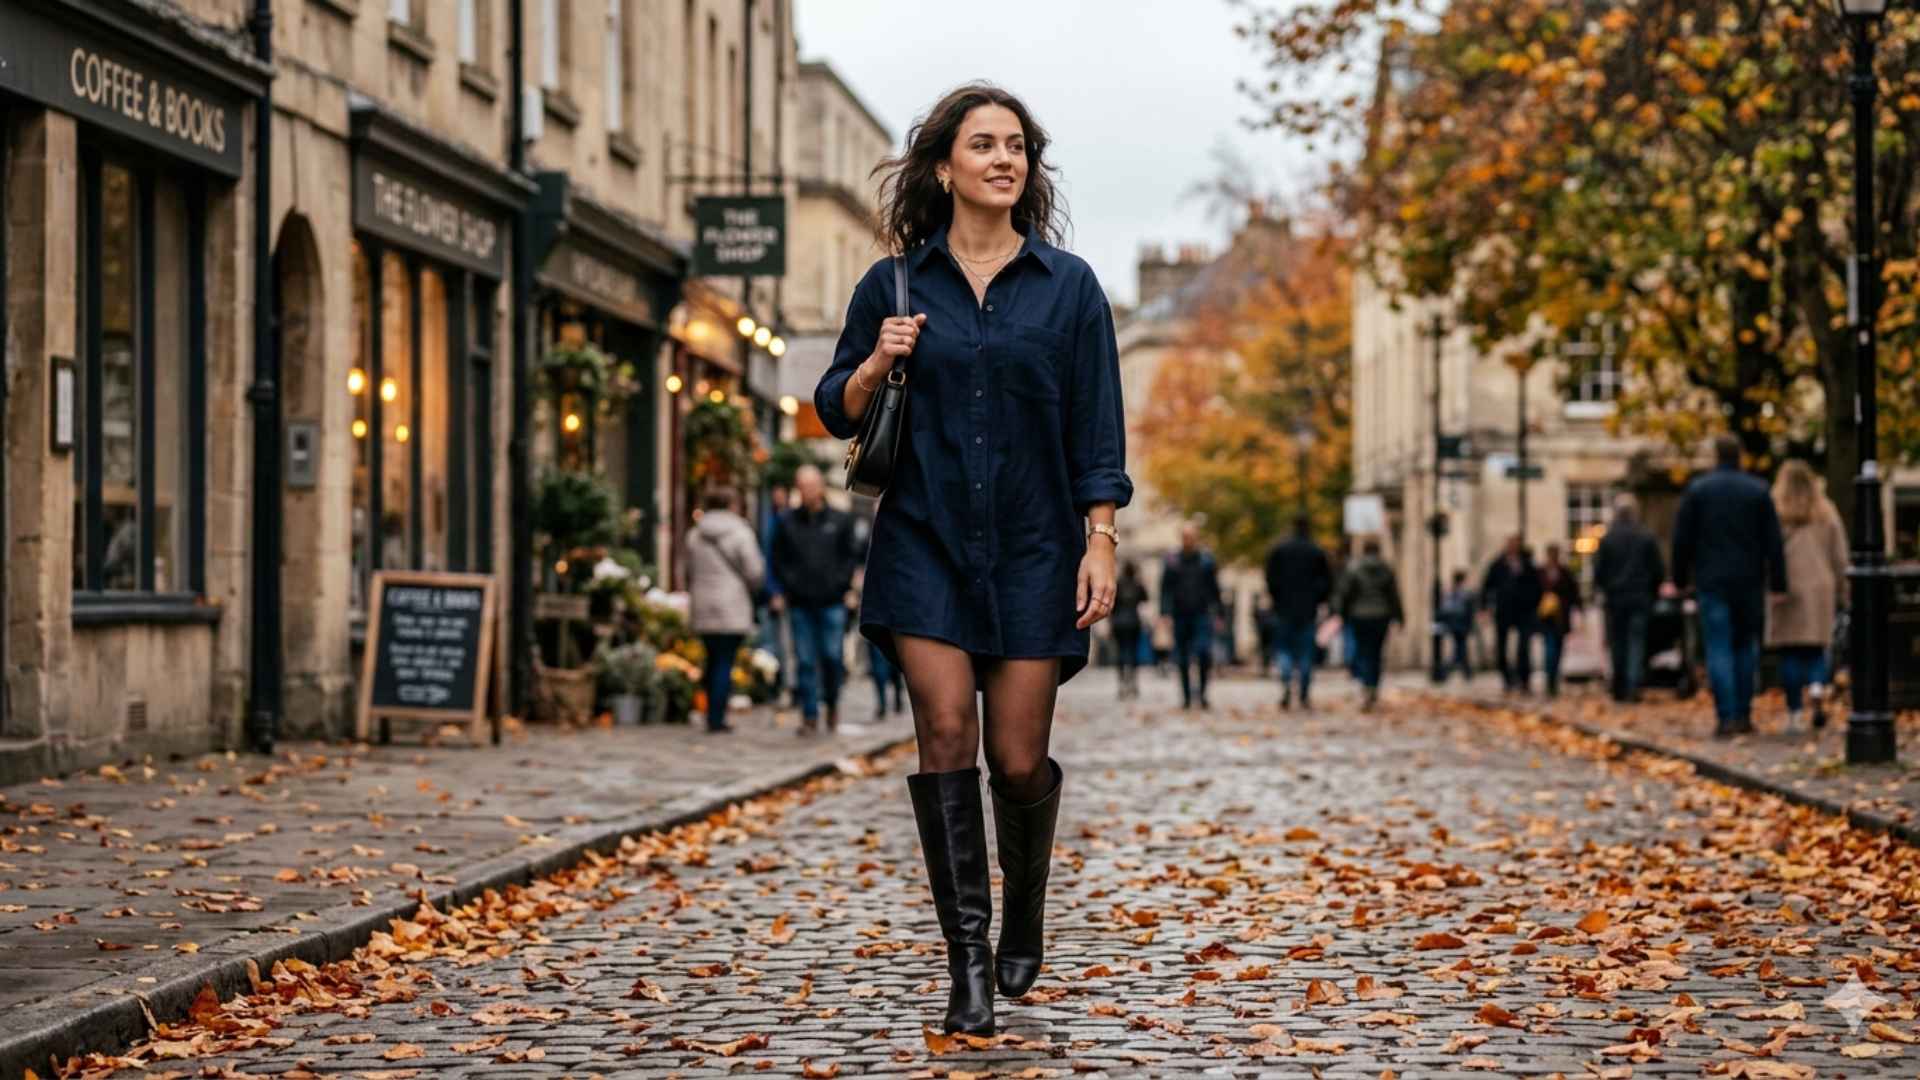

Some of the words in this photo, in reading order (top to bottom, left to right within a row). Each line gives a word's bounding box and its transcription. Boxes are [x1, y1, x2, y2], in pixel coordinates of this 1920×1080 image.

[70, 47, 144, 121] COFFEE
[148, 80, 161, 128] &
[165, 86, 225, 153] BOOKS
[372, 173, 402, 225] THE
[461, 212, 496, 258] SHOP
[723, 208, 758, 226] THE
[716, 247, 766, 263] SHOP
